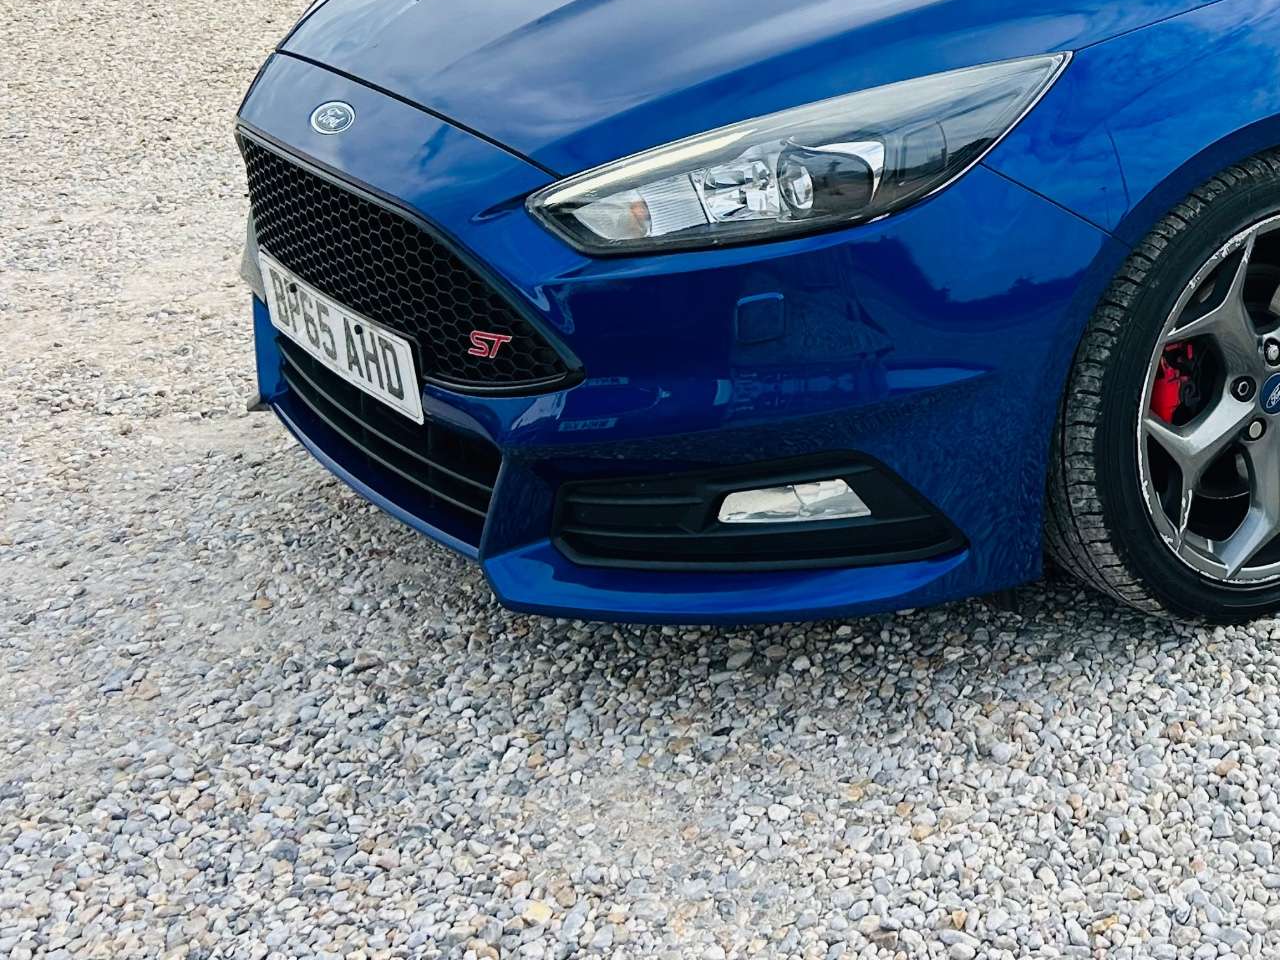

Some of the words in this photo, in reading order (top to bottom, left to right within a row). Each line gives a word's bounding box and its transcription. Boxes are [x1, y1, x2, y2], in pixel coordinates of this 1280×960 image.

[317, 107, 346, 128] Ford
[269, 268, 337, 361] BP65
[343, 316, 404, 401] AHD
[468, 330, 512, 358] ST
